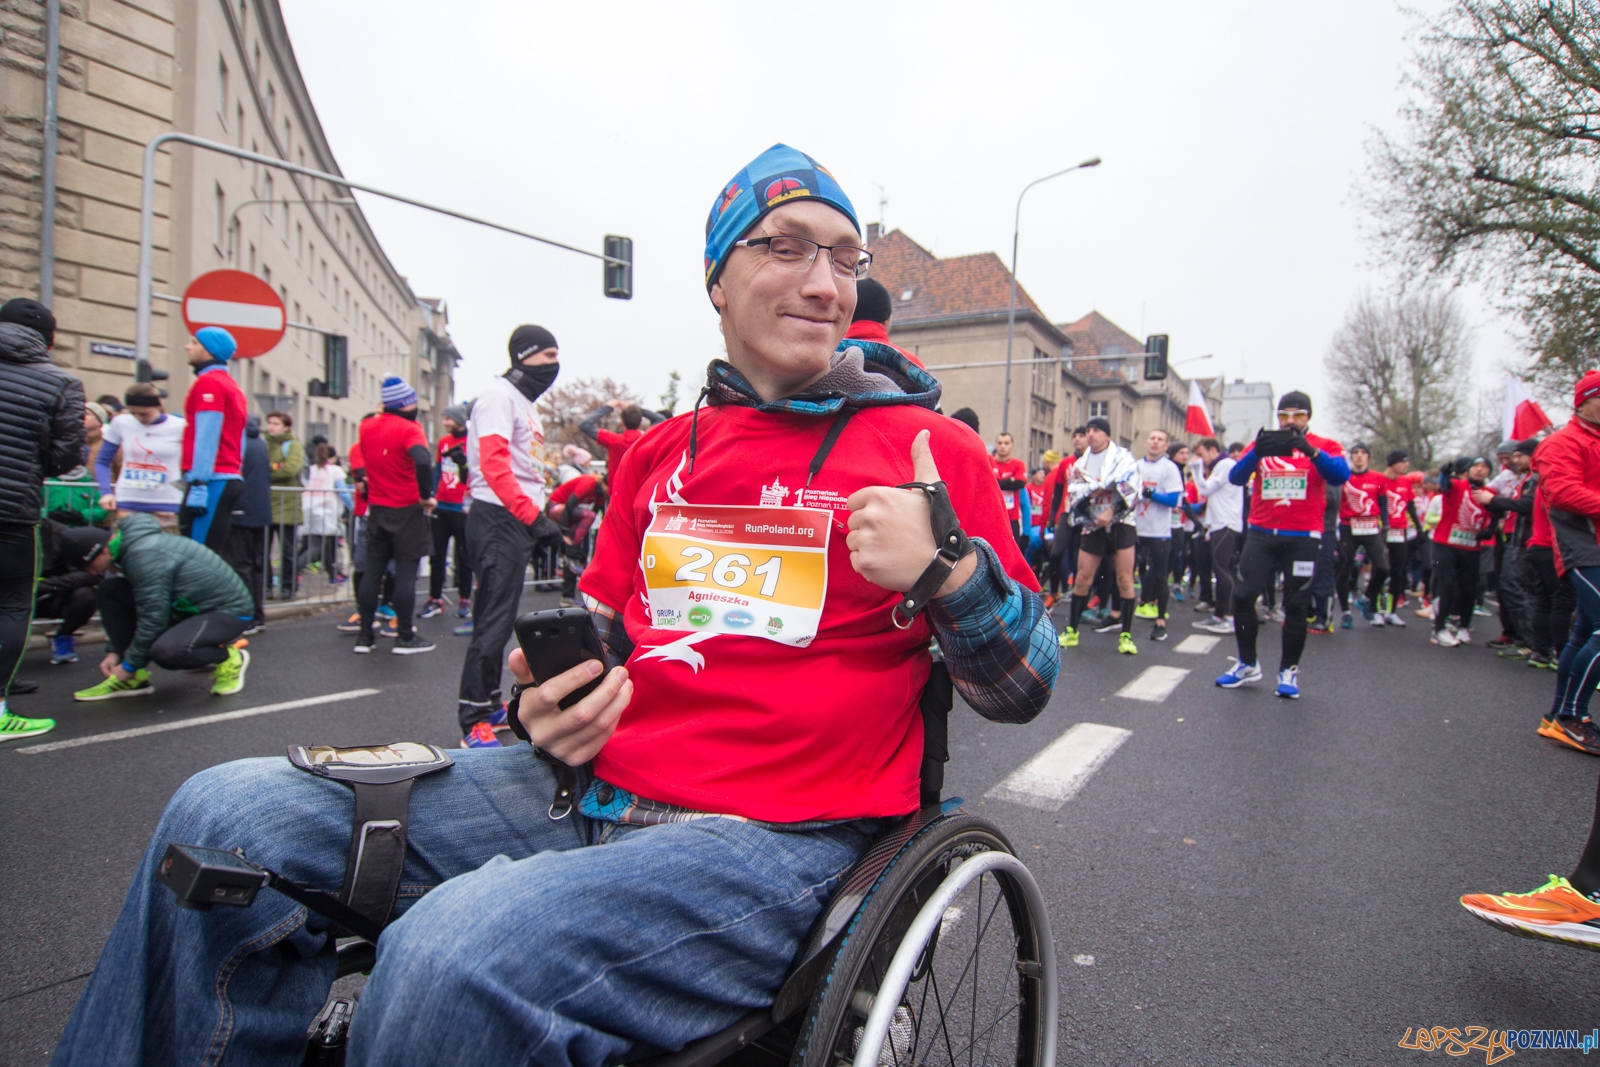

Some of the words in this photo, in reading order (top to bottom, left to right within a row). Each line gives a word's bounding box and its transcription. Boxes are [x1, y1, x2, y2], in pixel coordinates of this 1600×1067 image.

[1268, 478, 1302, 490] 3650
[793, 487, 804, 508] 1
[745, 524, 815, 538] RunPoland.org
[646, 554, 656, 569] D
[674, 545, 782, 598] 261
[688, 590, 750, 607] Agnieszka
[656, 609, 675, 617] GRUPA
